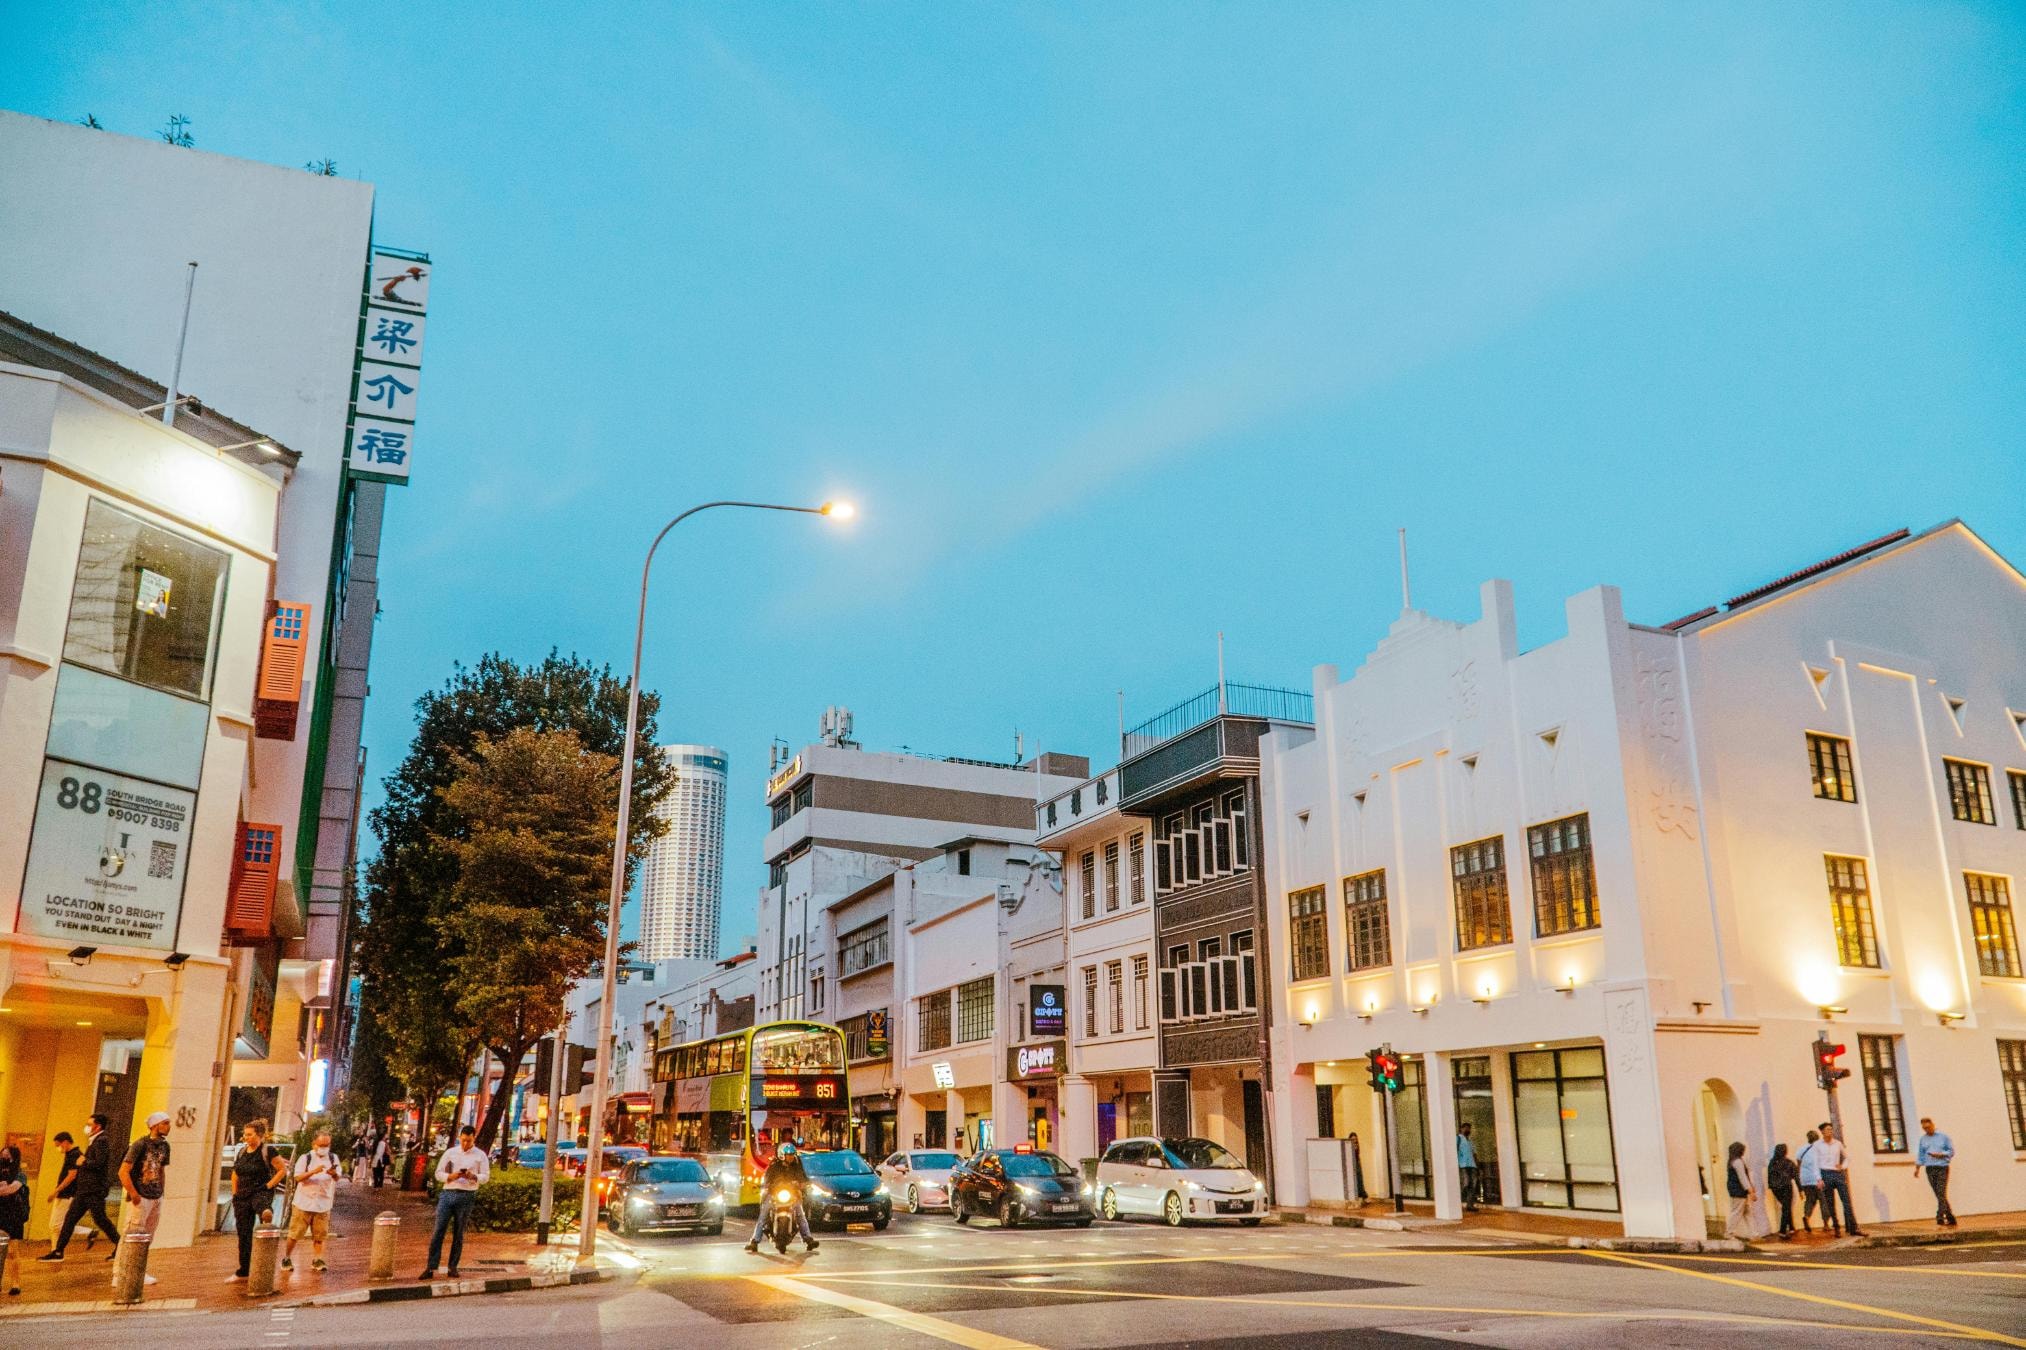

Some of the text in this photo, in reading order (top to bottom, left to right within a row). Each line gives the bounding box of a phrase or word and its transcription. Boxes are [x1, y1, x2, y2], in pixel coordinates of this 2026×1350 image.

[357, 317, 418, 466] 梁介福
[56, 776, 103, 815] 88
[106, 788, 134, 801] SOUTH
[135, 795, 164, 808] BRIDGE
[165, 802, 187, 813] ROAD
[115, 809, 148, 825] 9007
[150, 816, 180, 832] 8398
[45, 906, 163, 930] YOU STAND OUT DAY & NIGHT
[46, 894, 165, 920] LOCATION SO BRIGHT
[55, 920, 153, 940] EVEN IN BLACK & WHITE
[816, 1084, 835, 1098] 851
[175, 1105, 196, 1129] 88
